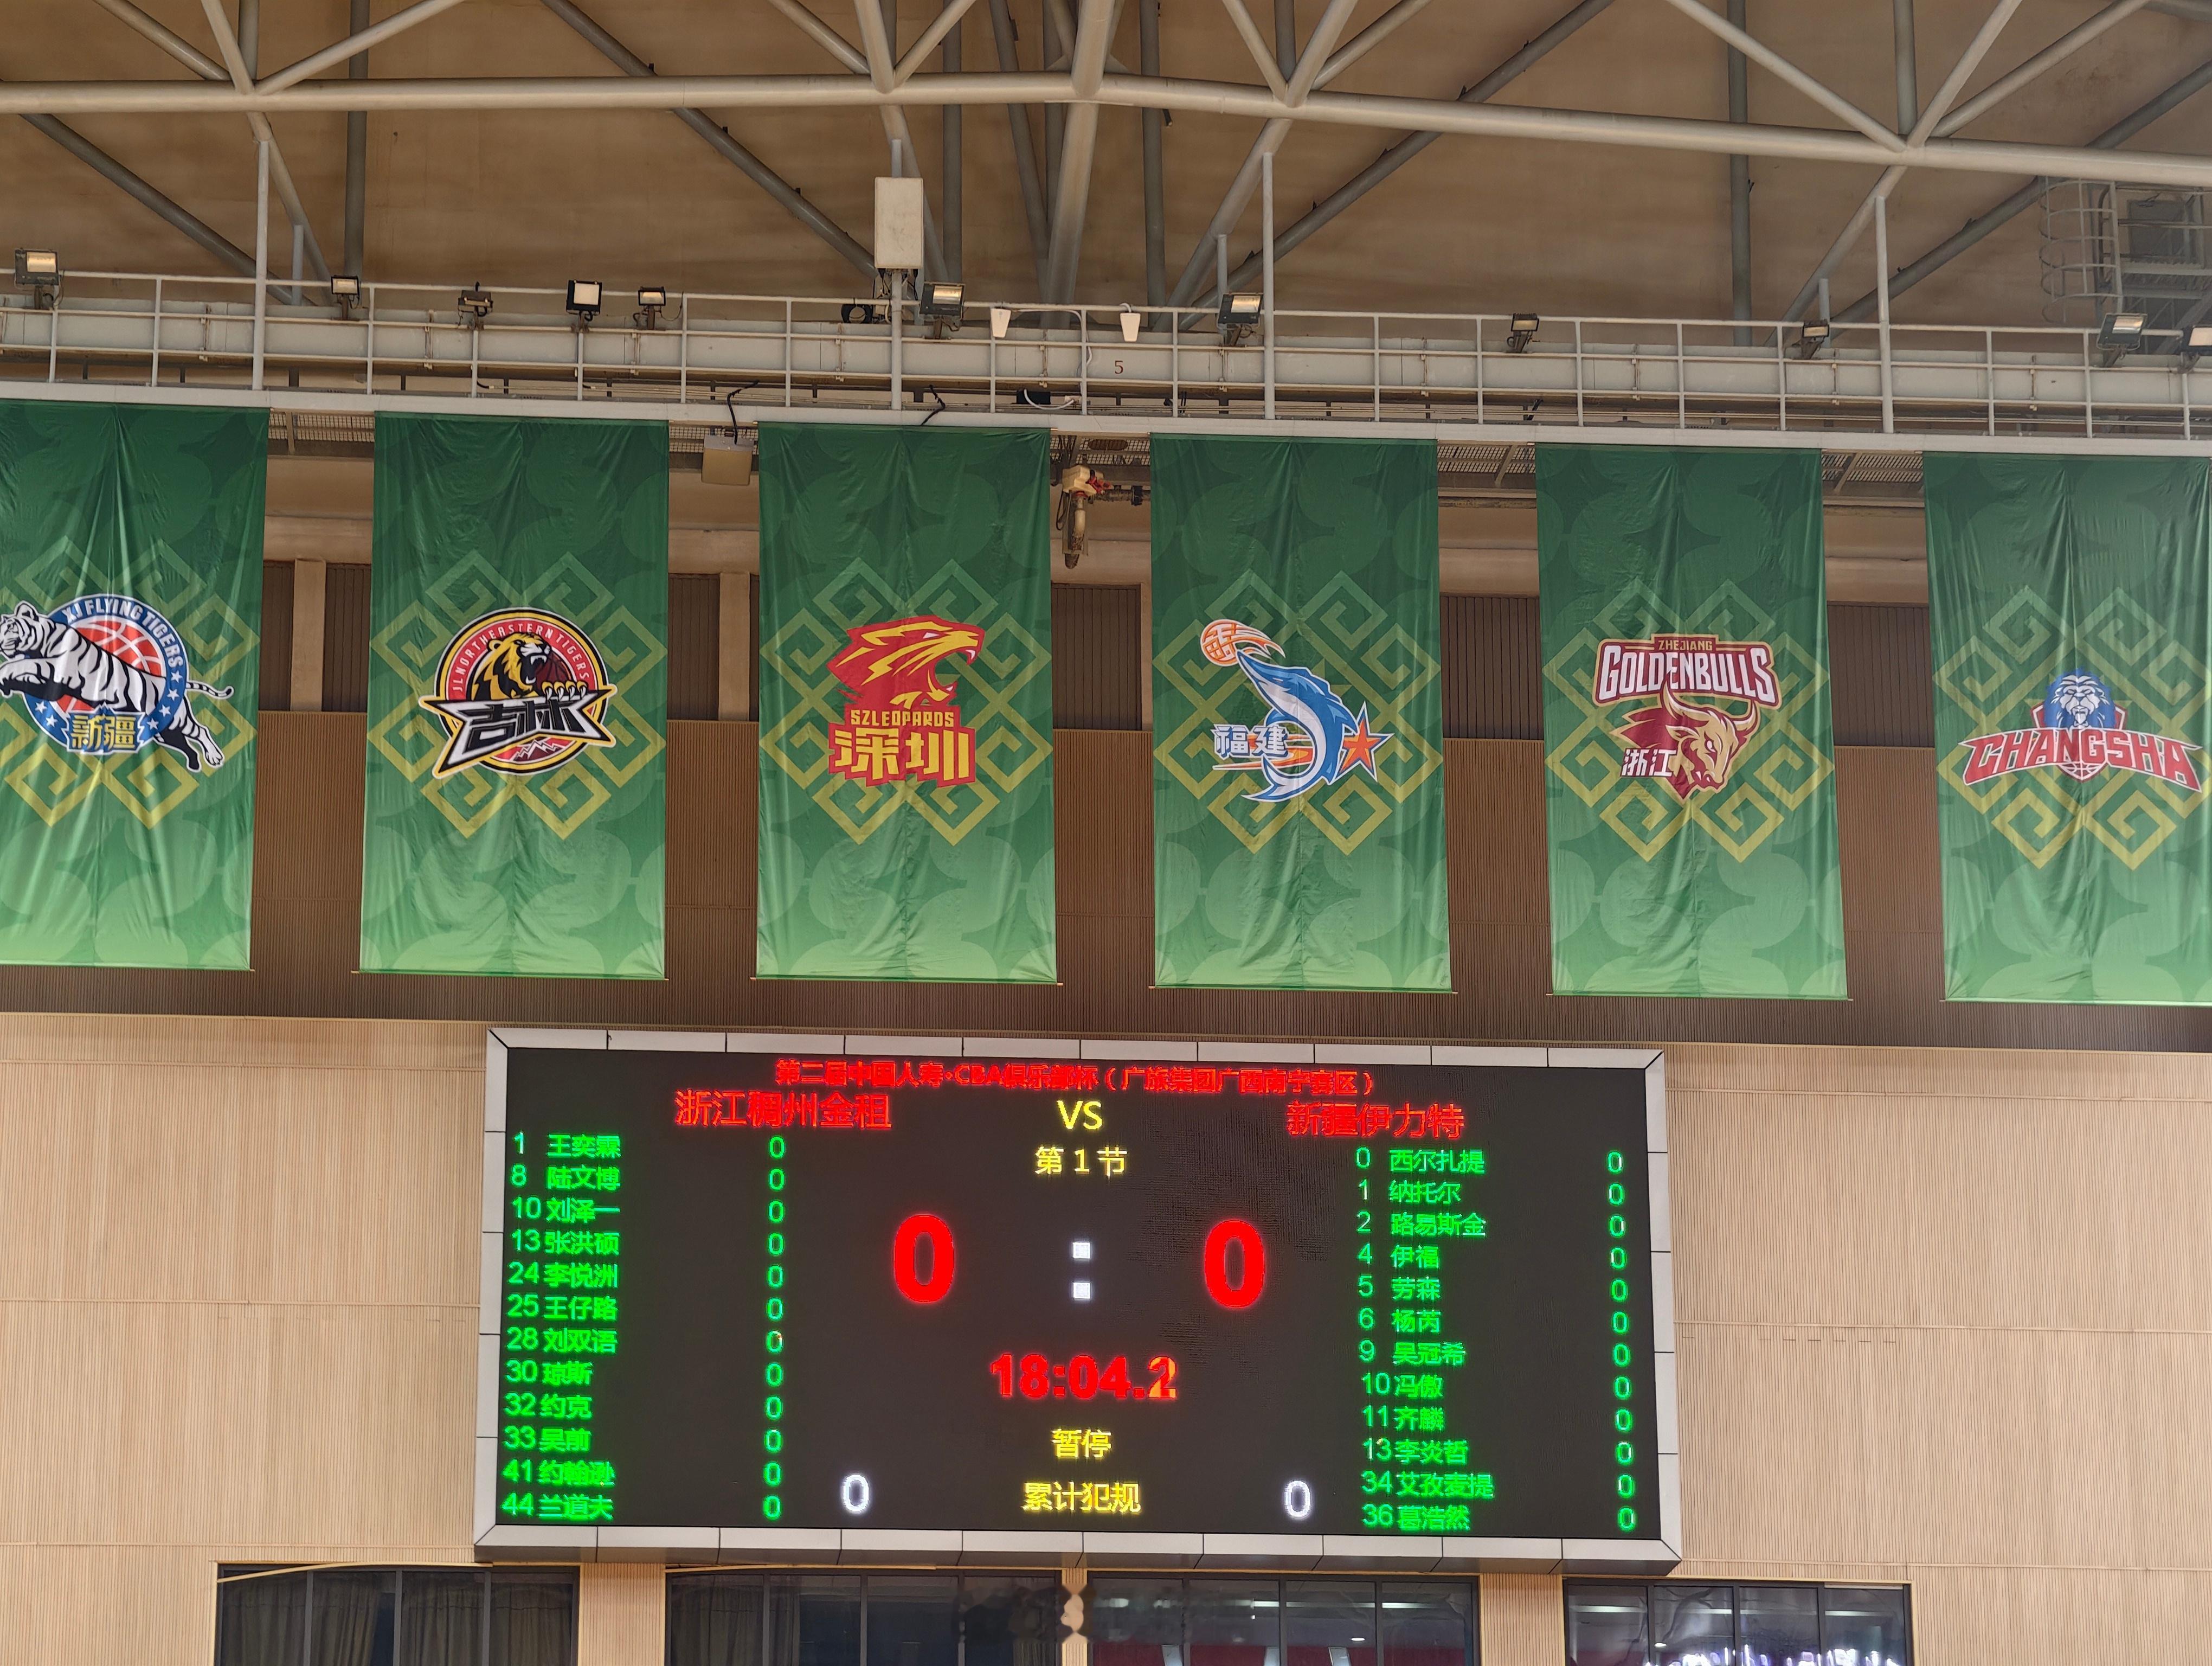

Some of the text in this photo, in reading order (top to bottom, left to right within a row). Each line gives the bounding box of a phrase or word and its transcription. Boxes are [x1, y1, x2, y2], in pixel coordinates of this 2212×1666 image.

[1115, 360, 1123, 374] 5
[62, 598, 183, 668] XJ FLYING TIGERS
[1658, 639, 1713, 651] ZHEJIANG
[556, 633, 589, 680] TIGERS
[458, 699, 587, 754] 吉林
[834, 728, 969, 781] 深圳
[1213, 725, 1289, 758] 福建
[1621, 748, 1677, 777] 浙江
[1959, 727, 2203, 792] CHANGSHA
[675, 1089, 892, 1130] 浙江稠州金租
[1056, 1100, 1103, 1130] VS
[1287, 1100, 1464, 1138] 新疆伊力特
[513, 1131, 525, 1154] 1
[769, 1136, 785, 1159] 0
[1356, 1146, 1623, 1174] 0 西尔扎提 0
[511, 1163, 785, 1191] 8 陆文博 0
[1358, 1179, 1625, 1206] 1 纳托尔 0
[512, 1196, 785, 1223] 10 刘泽一 0
[1356, 1211, 1626, 1238] 2 路易斯金 0
[511, 1229, 784, 1257] 13 张洪硕 0
[1358, 1243, 1628, 1270] 4 伊福 0
[508, 1261, 784, 1289] 24 李悦洲 0
[893, 1214, 954, 1304] 0
[1204, 1219, 1265, 1308] 0
[1358, 1275, 1629, 1303] 5 劳森 0
[507, 1294, 784, 1321] 25 王仔路 0
[1359, 1308, 1375, 1330] 6
[1612, 1311, 1629, 1335] 0
[506, 1327, 783, 1354] 28 刘双语 0
[1359, 1340, 1631, 1367] 9 吴冠希 0
[505, 1359, 783, 1387] 30 琼斯 0
[991, 1354, 1176, 1400] 18:04.2
[1361, 1372, 1632, 1400] 10 冯傲 0
[504, 1392, 783, 1420] 32 约克 0
[1362, 1405, 1633, 1432] 11 齐麟 0
[503, 1425, 783, 1454] 33 吴前 0
[1052, 1428, 1113, 1459] 暂停
[1362, 1438, 1392, 1461] 13
[1615, 1442, 1634, 1466] 0
[502, 1459, 782, 1487] 41 约翰逊 0
[1361, 1470, 1635, 1499] 34 艾孜麦提 0
[501, 1492, 781, 1521] 44 兰道夫 0
[841, 1473, 870, 1515] 0
[1022, 1481, 1142, 1515] 累计犯规
[1283, 1479, 1313, 1520] 0
[1361, 1503, 1394, 1528] 36
[1617, 1507, 1636, 1532] 0
